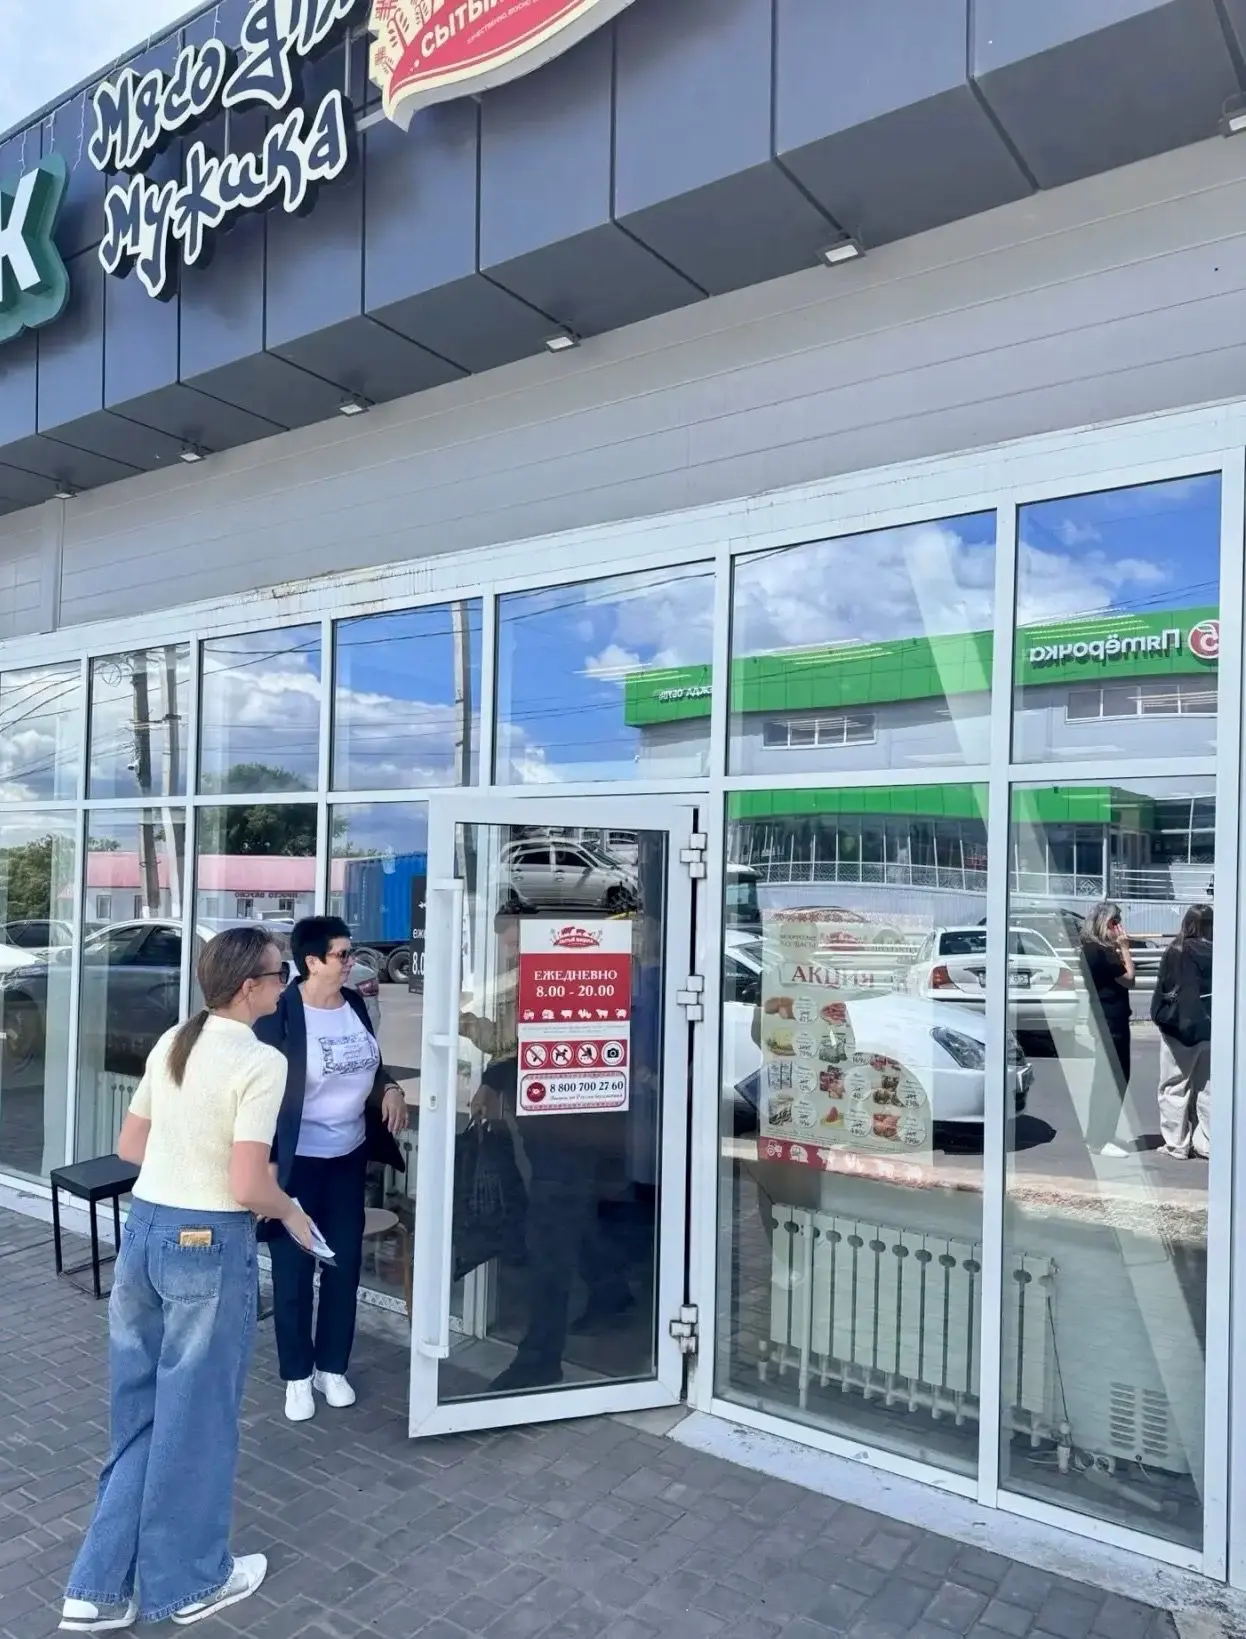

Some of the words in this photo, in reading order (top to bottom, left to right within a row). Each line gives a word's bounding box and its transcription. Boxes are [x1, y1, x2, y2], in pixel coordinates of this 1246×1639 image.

[98, 88, 348, 298] Мужика
[534, 969, 618, 982] ЕЖЕДНЕВНО
[791, 965, 875, 989] АКЦИЯ
[536, 985, 566, 998] 8.00
[577, 984, 615, 997] 20.00
[550, 1083, 556, 1093] 8
[558, 1082, 576, 1093] 800
[579, 1081, 597, 1092] 700
[599, 1081, 610, 1091] 27
[612, 1080, 624, 1091] 60
